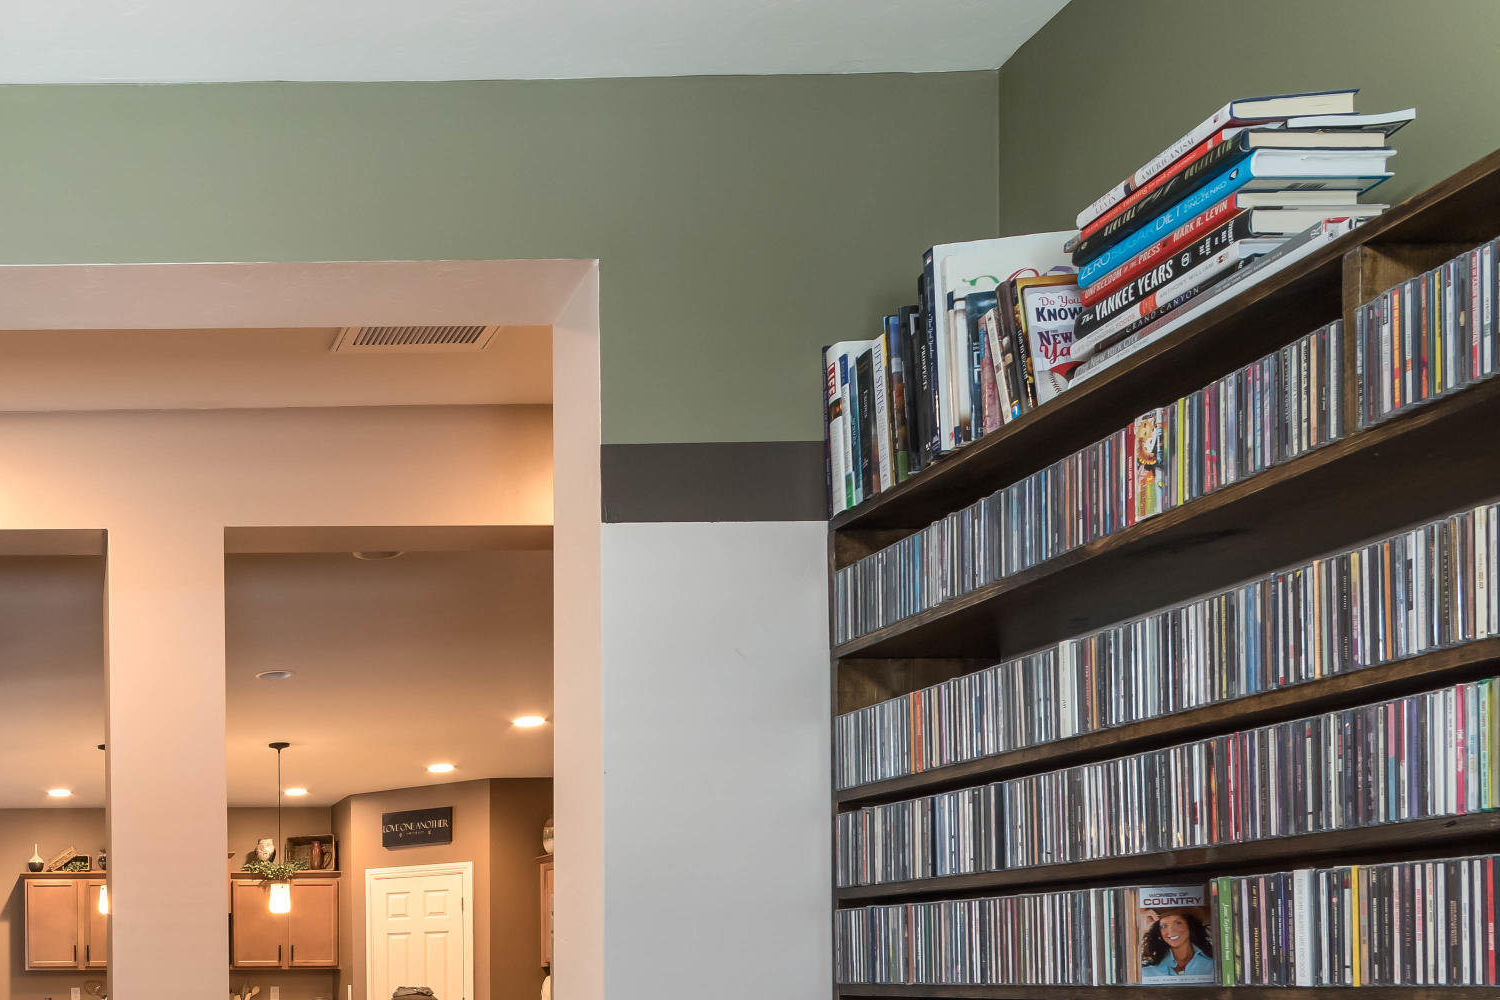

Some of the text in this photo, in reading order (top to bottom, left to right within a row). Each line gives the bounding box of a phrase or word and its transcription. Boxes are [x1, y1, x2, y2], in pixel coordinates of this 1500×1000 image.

[1173, 199, 1228, 243] MARK R. LEVIN
[1080, 253, 1111, 281] ZERO
[1155, 205, 1181, 232] DIET
[1084, 267, 1123, 299] UNFREEDOM
[1138, 243, 1162, 265] PRESS
[1039, 296, 1081, 307] Do You
[1081, 259, 1174, 325] The YANKEE YEARS
[1160, 286, 1200, 314] CANYON
[1035, 307, 1083, 322] KNOW
[1037, 331, 1073, 346] NEW
[828, 362, 837, 398] LIFE
[873, 343, 885, 414] FIFTY STATES
[920, 344, 928, 391] PROSPECTS
[383, 823, 399, 833] LOVE
[400, 822, 416, 832] ONE
[415, 819, 449, 830] ANOTHER
[1143, 897, 1202, 906] COUNTRY
